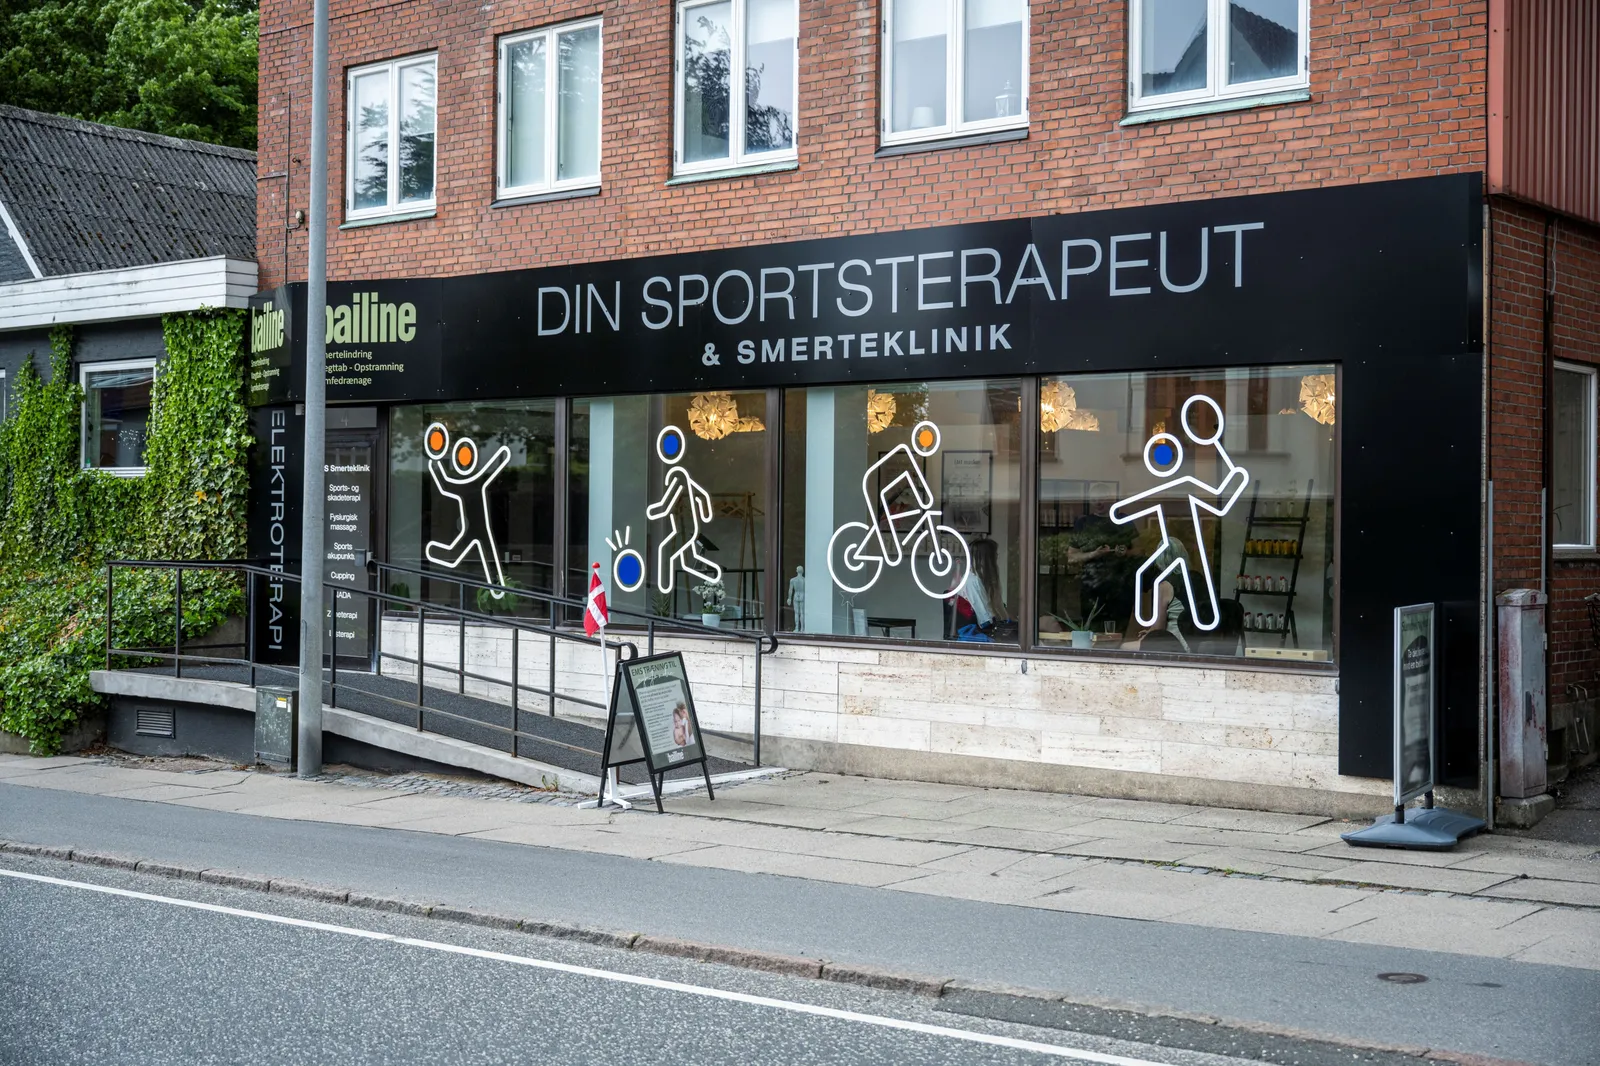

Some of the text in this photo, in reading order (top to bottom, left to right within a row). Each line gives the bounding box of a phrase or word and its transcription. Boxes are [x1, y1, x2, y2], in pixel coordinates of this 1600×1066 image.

[537, 222, 1264, 337] DIN SPORTSTERAPEUT
[251, 300, 285, 354] bailine
[701, 323, 1012, 367] & SMERTEKLINIK
[325, 350, 373, 360] ertelindring
[325, 363, 348, 373] gttab
[354, 362, 404, 373] Opstramning
[325, 376, 372, 386] mfedrænage
[330, 464, 370, 473] Smerteklinik
[351, 486, 360, 495] og
[327, 494, 361, 503] skadeterapi
[330, 513, 358, 523] Fysiurgisk
[268, 410, 286, 650] ELEKTROTERAPI
[330, 524, 357, 533] massage
[333, 542, 353, 551] Sports
[330, 571, 355, 581] Cupping
[631, 667, 644, 677] EMS
